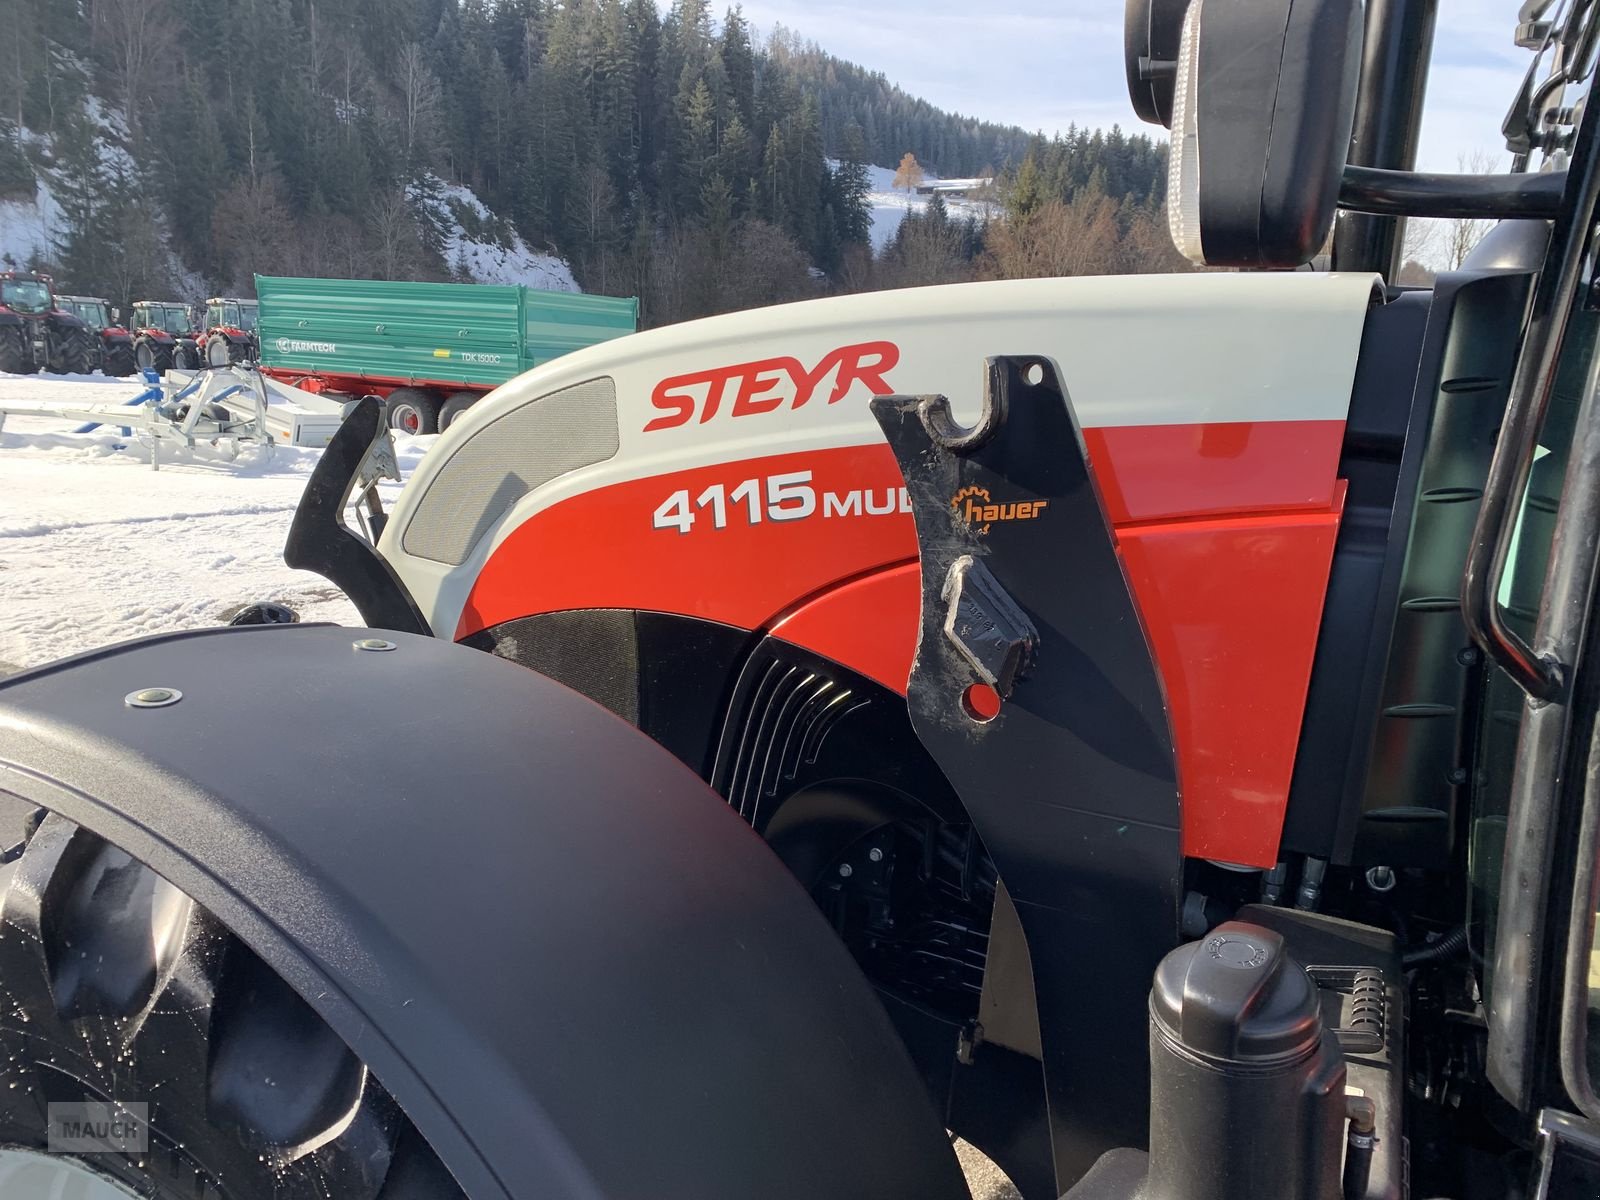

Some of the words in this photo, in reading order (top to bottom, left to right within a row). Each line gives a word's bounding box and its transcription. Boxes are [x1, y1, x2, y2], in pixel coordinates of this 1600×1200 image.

[291, 341, 336, 353] FARMTECH
[642, 341, 900, 433] STEYR
[653, 470, 817, 535] 4115
[965, 499, 1047, 522] hauer
